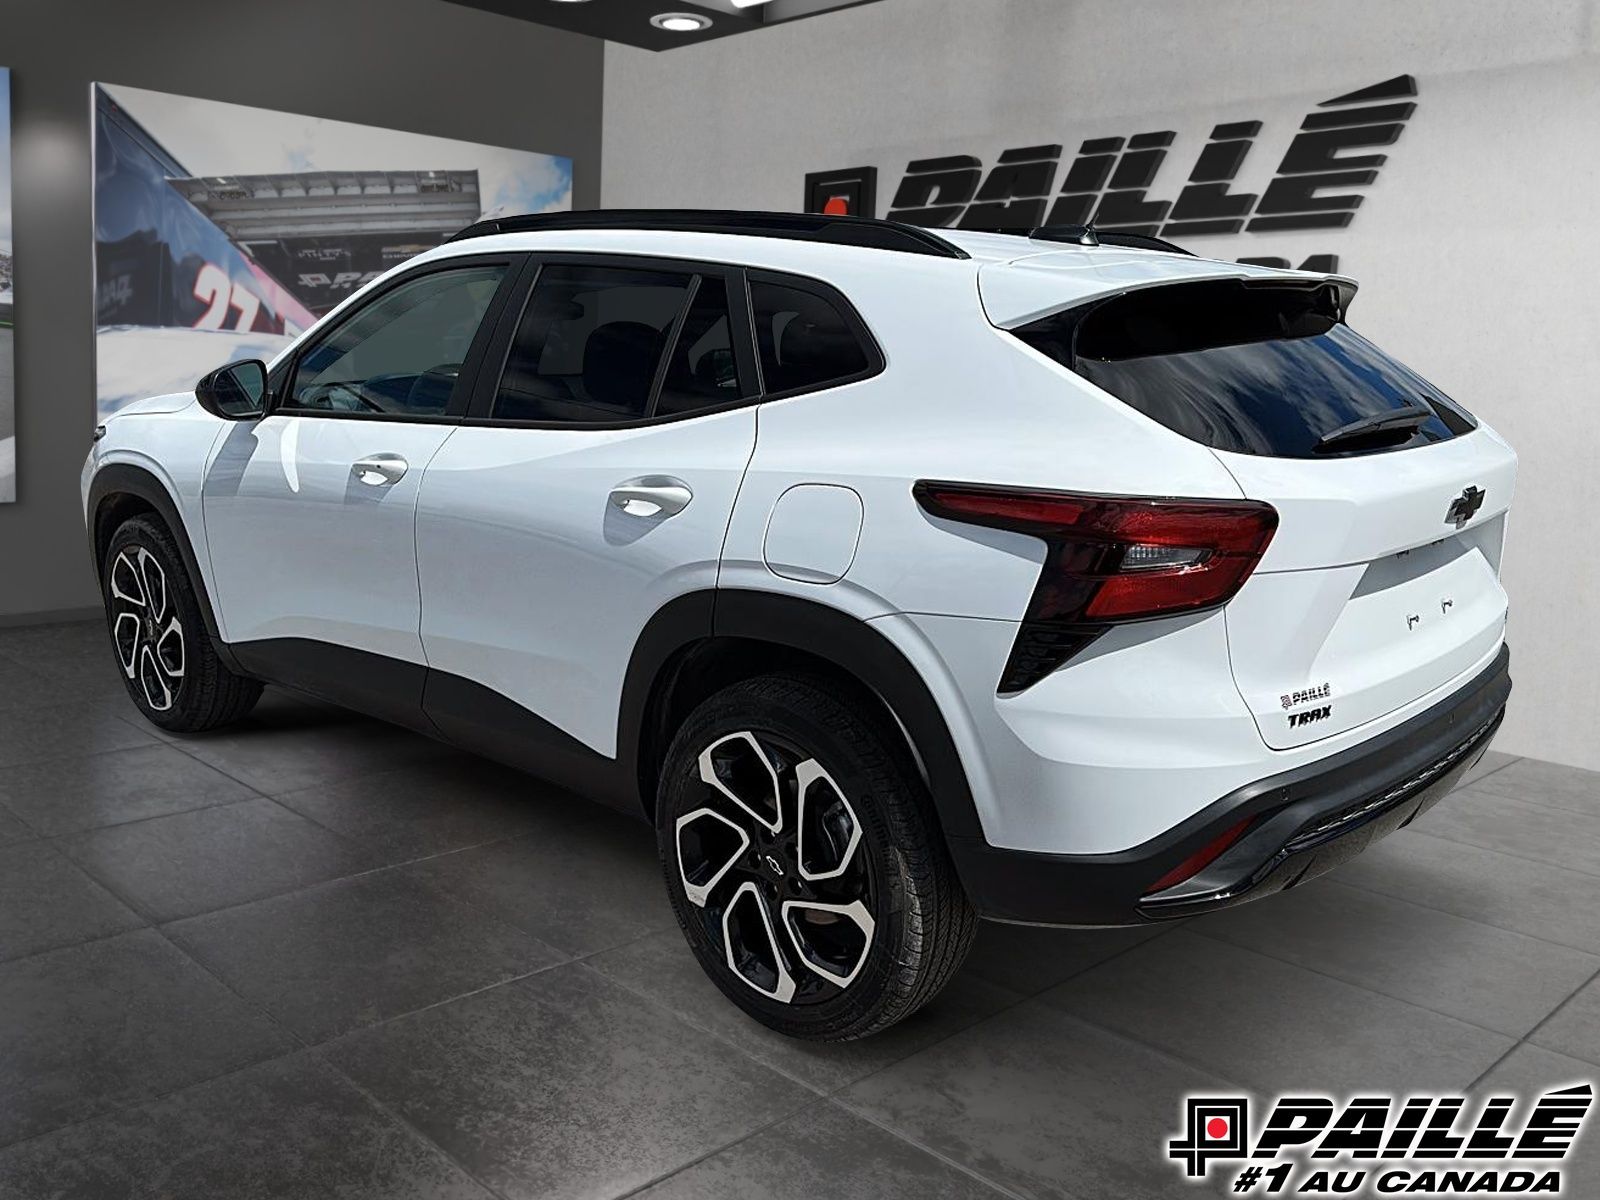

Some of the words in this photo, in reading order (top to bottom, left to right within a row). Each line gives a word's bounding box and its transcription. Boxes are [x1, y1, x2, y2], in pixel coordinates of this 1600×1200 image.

[886, 73, 1418, 237] PAILLÉ
[193, 262, 260, 332] 27
[1288, 704, 1332, 729] TRAX
